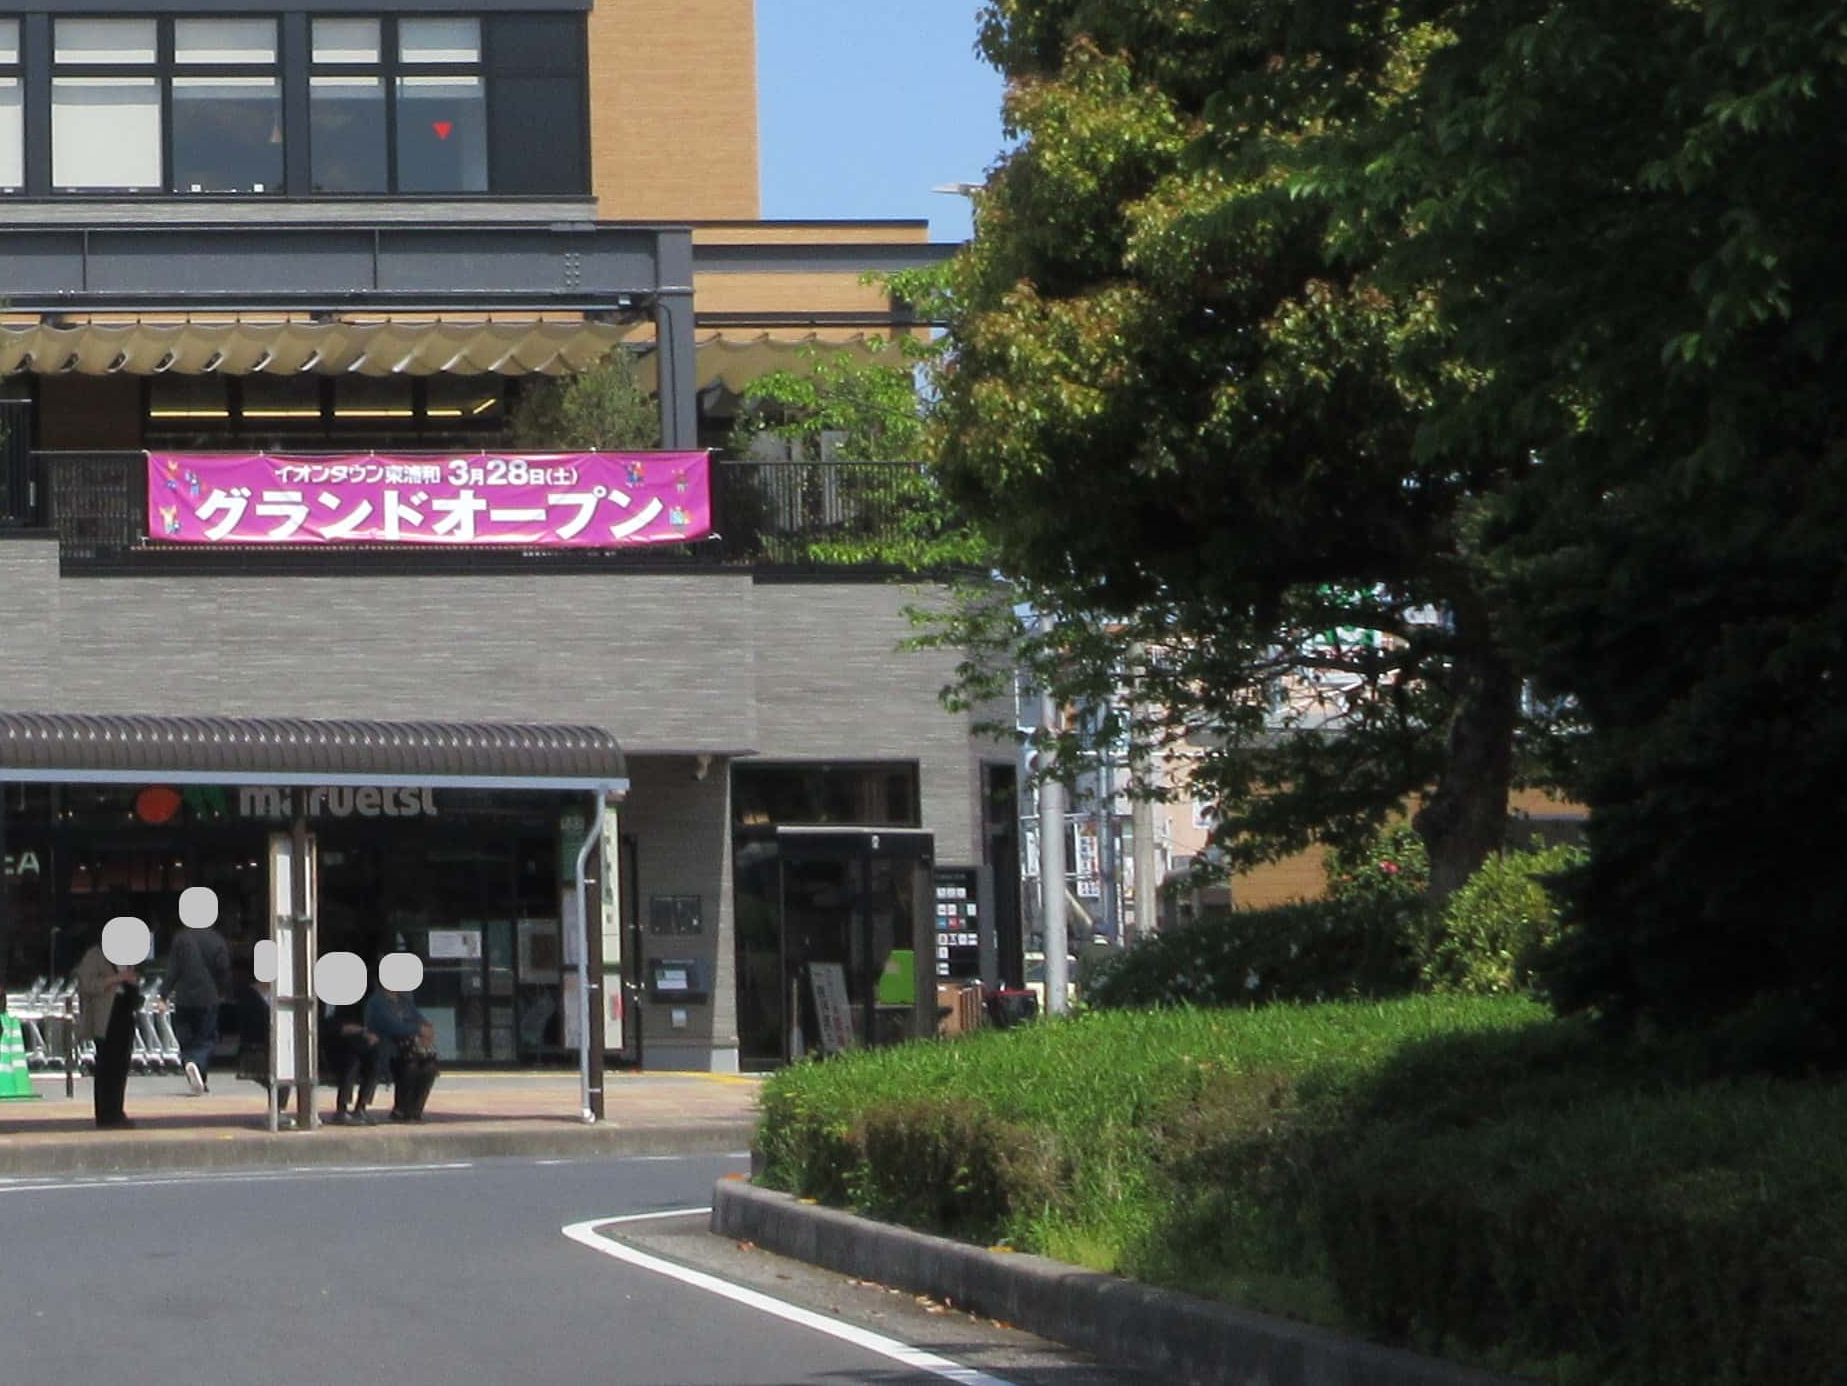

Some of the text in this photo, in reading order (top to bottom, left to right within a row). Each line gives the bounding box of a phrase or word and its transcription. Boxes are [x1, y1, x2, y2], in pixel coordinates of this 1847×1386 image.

[274, 459, 575, 487] イオンタウン東浦和 3月28日(土)
[195, 486, 663, 542] グランドオープン
